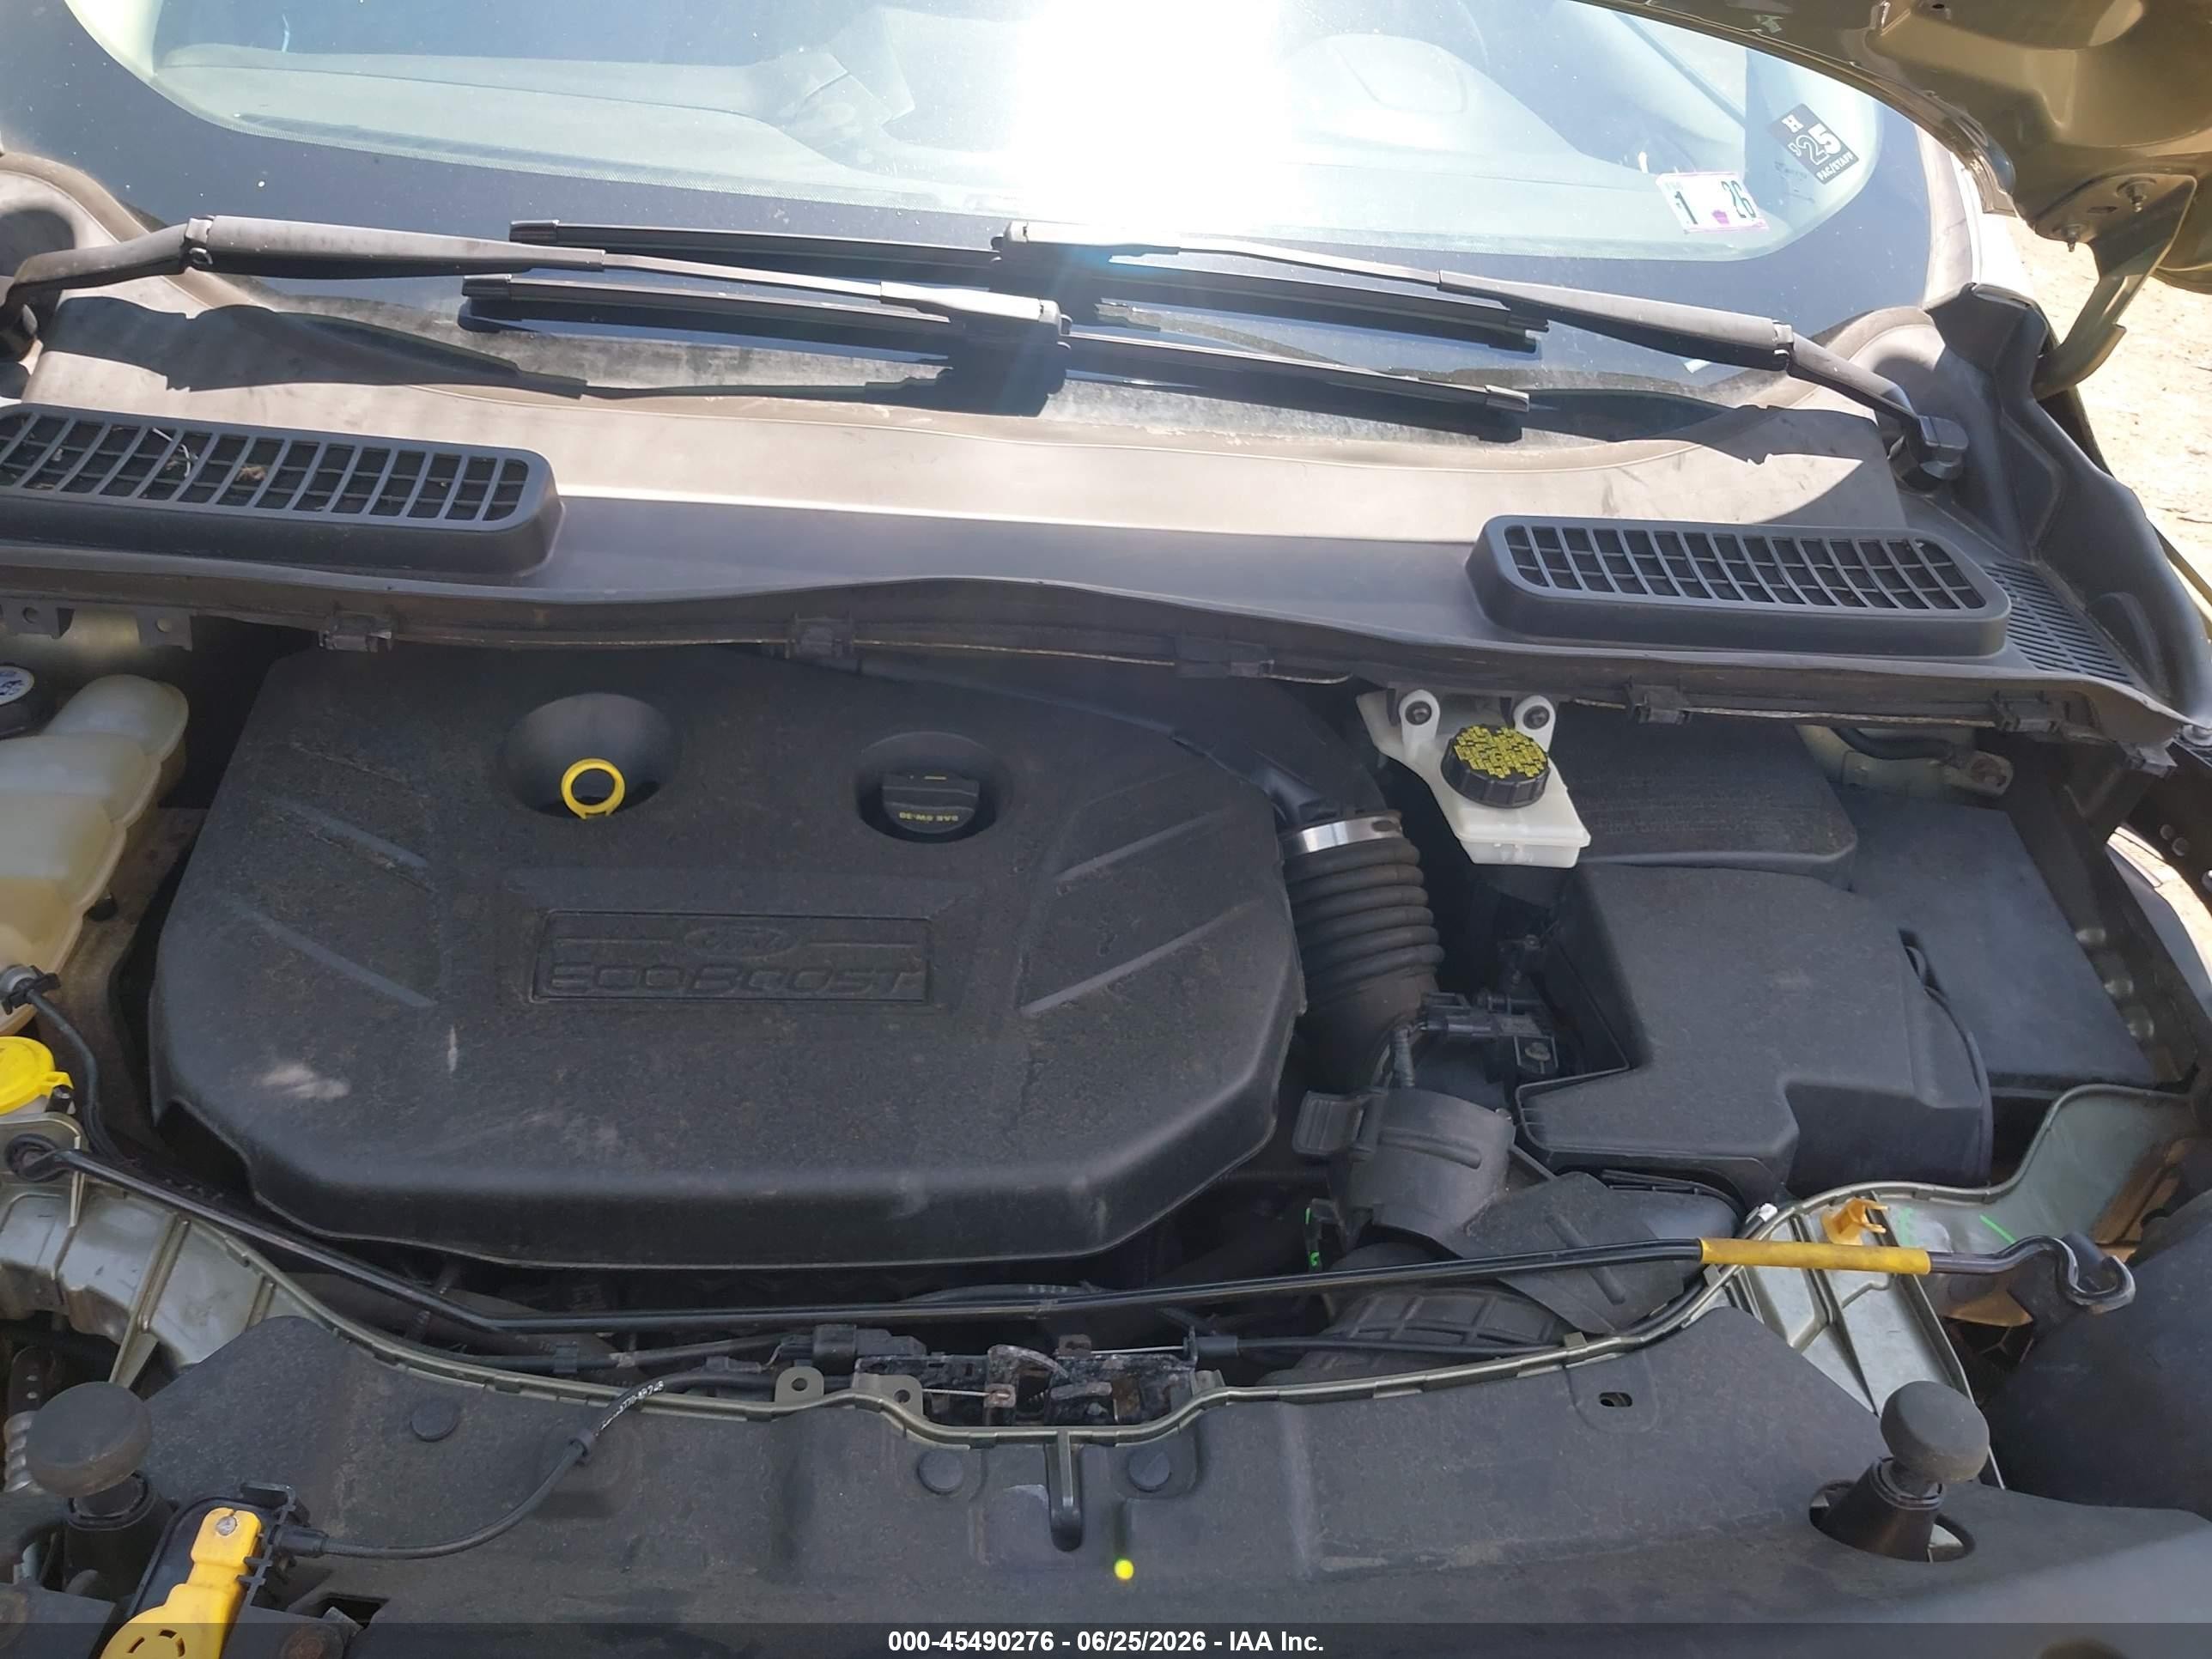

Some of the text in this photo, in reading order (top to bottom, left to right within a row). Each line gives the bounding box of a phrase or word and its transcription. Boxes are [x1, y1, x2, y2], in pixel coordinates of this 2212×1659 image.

[1782, 114, 1804, 133] H
[1674, 180, 1757, 225] 1 26
[549, 962, 926, 995] ECOBOOST
